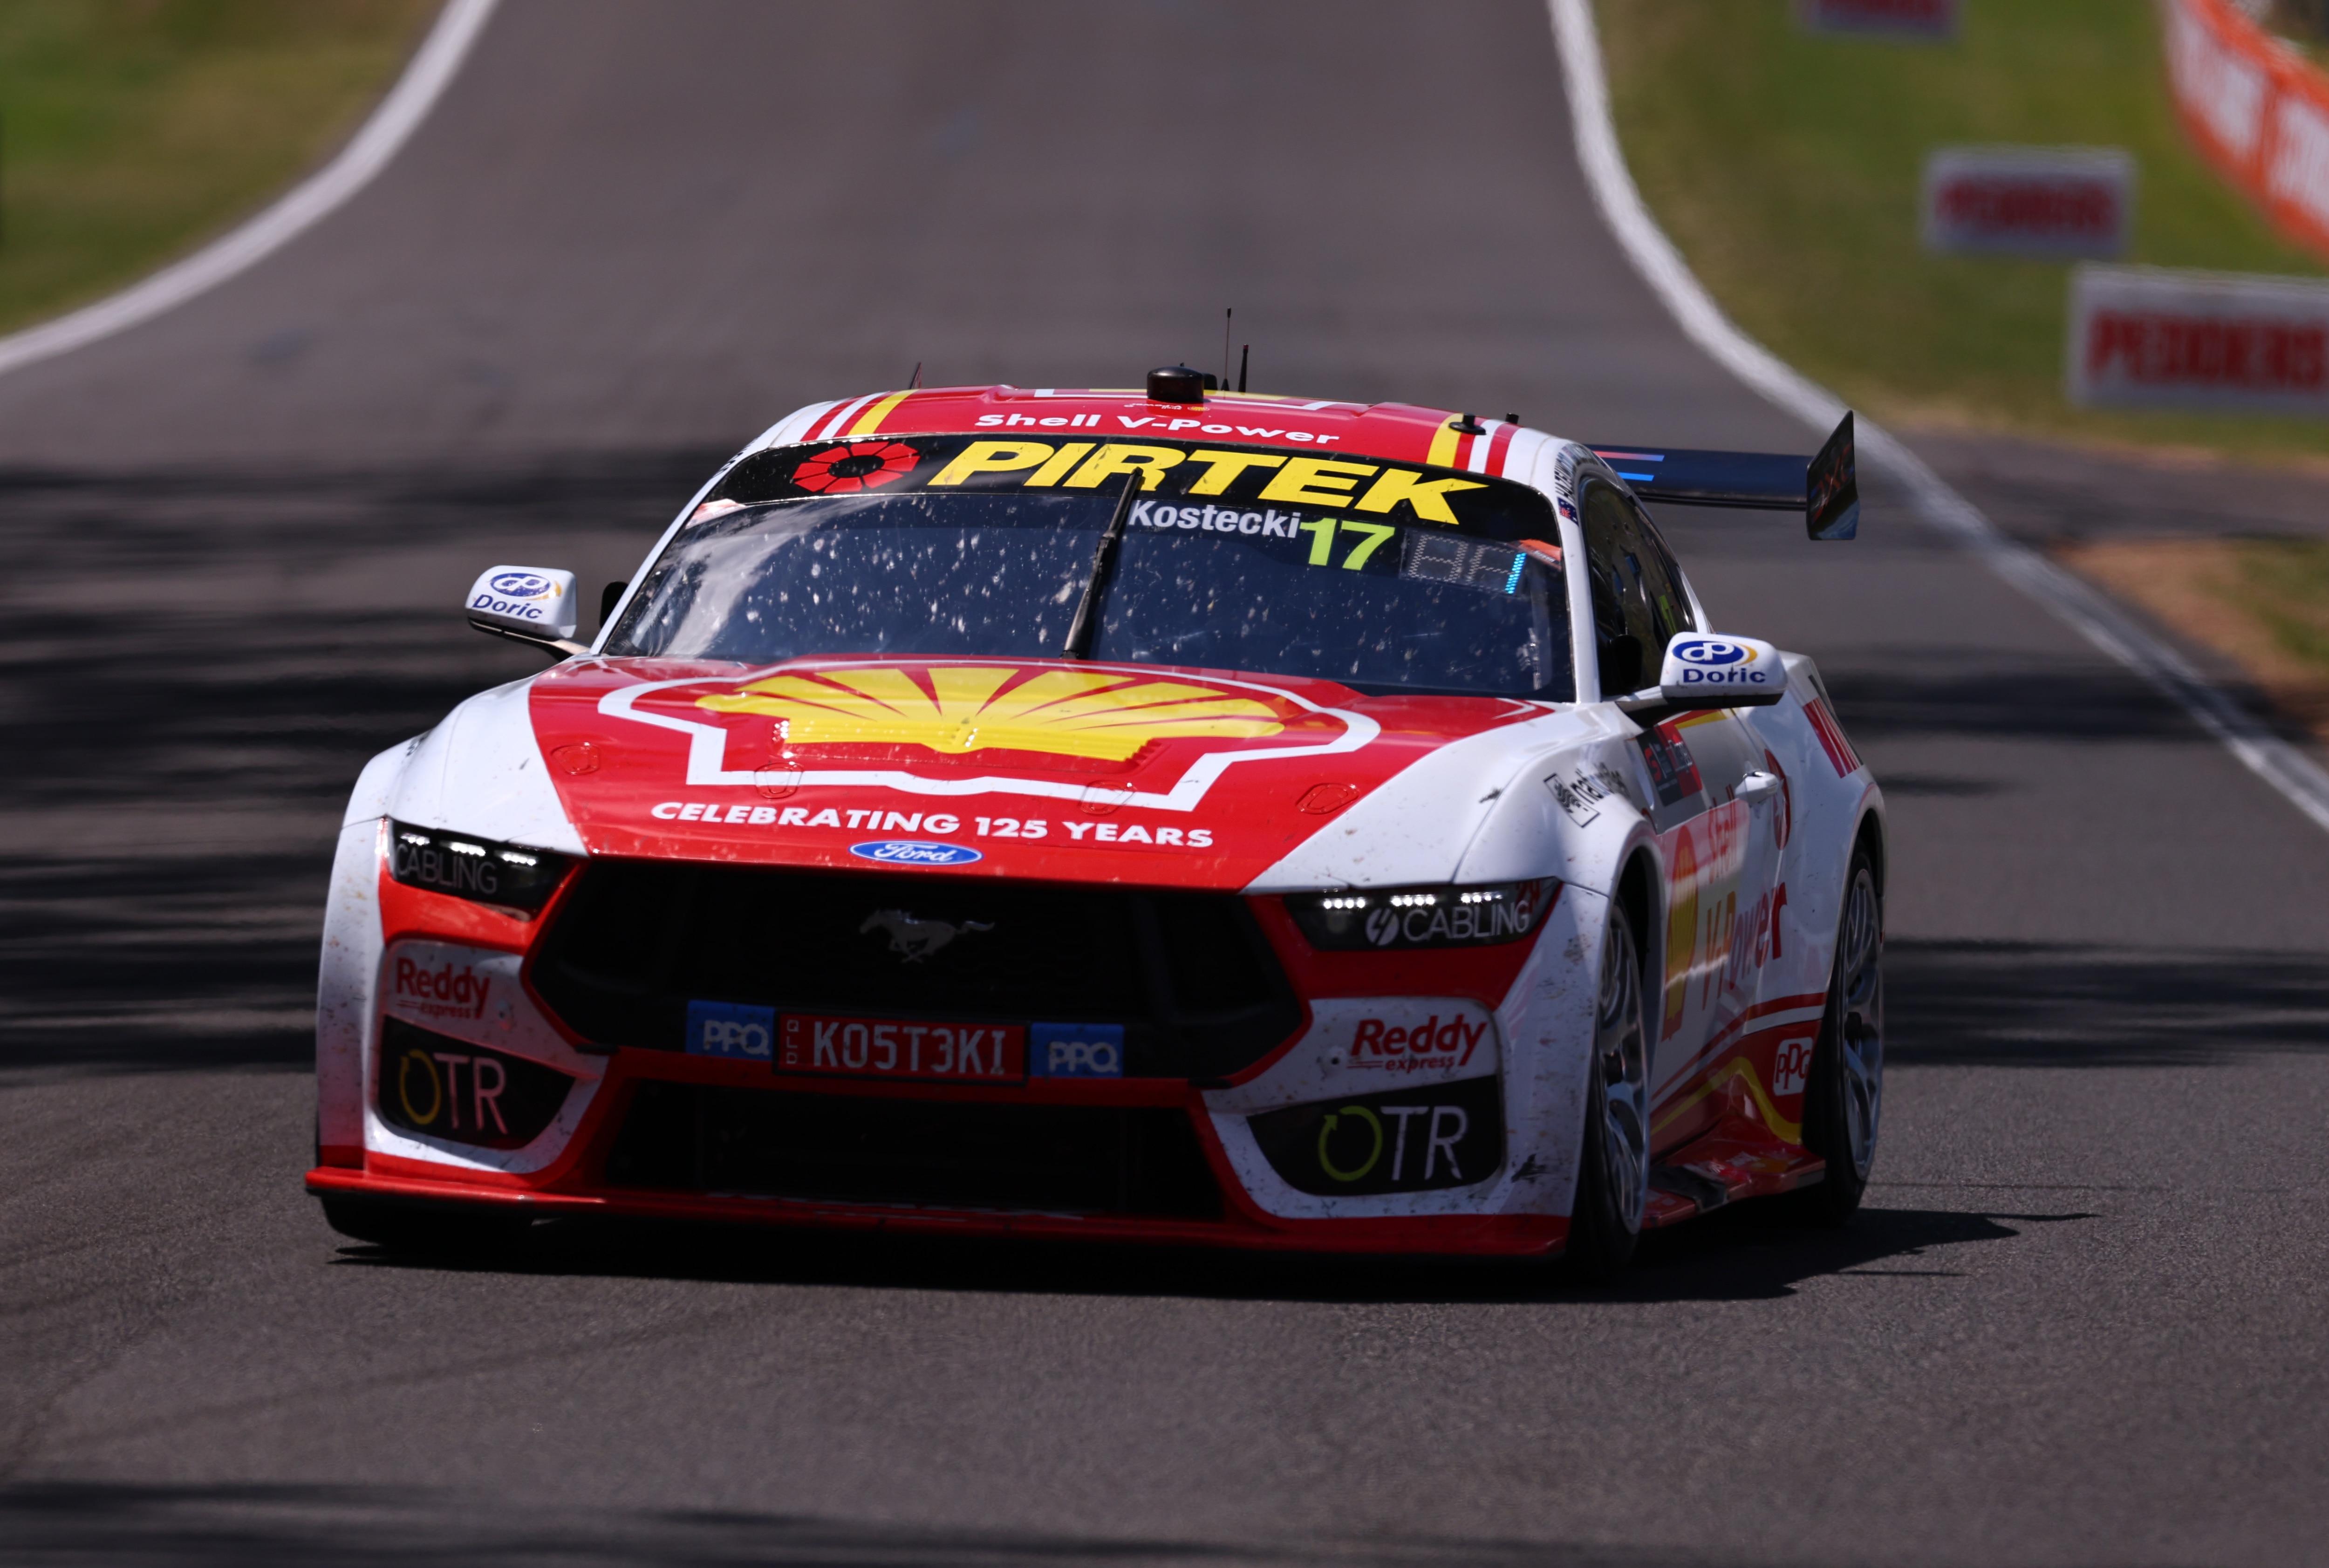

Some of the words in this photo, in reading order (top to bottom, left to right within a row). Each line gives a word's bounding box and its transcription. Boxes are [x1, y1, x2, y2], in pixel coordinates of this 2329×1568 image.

[975, 413, 1101, 427] Shell
[1117, 416, 1339, 444] V-Power
[927, 440, 1489, 525] PIRTEK
[1128, 500, 1303, 539] Kostecki
[1300, 518, 1395, 570] 17
[471, 593, 543, 619] Doric
[1682, 668, 1766, 683] Doric
[651, 802, 960, 834] CELEBRATING
[975, 818, 1048, 839] 125
[1062, 821, 1213, 847] YEARS
[396, 844, 497, 894] CABLING
[874, 842, 957, 863] Ford
[1404, 901, 1530, 941] CABLING
[396, 957, 490, 1019] Reddy
[420, 1002, 472, 1019] express
[703, 1019, 771, 1056] PPQ
[1048, 1041, 1119, 1073] PPQ
[1351, 1015, 1488, 1066] Reddy
[1385, 1054, 1455, 1073] express
[400, 1050, 508, 1135] OTR
[1318, 1105, 1468, 1181] OTR
